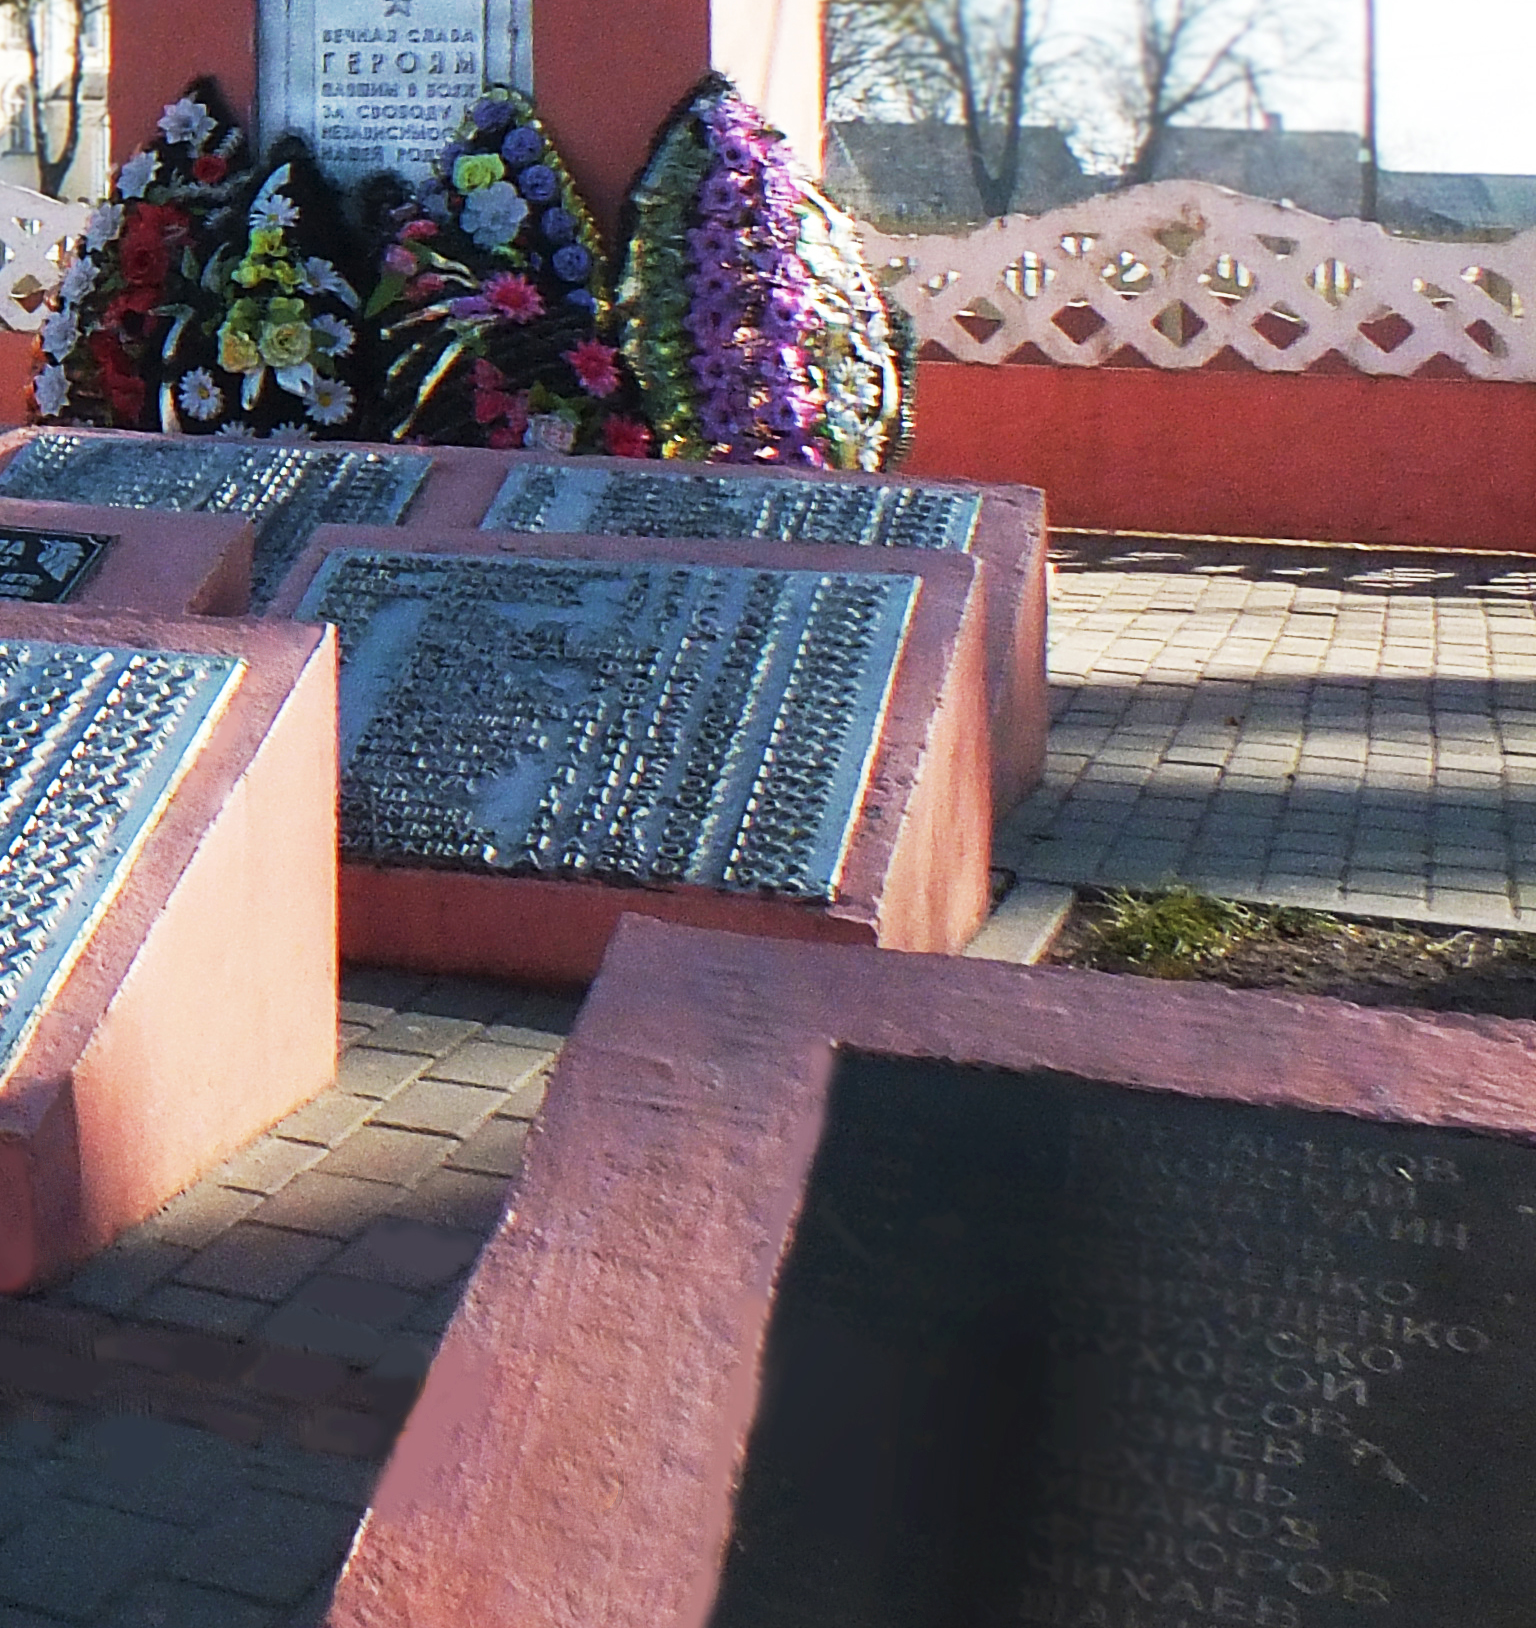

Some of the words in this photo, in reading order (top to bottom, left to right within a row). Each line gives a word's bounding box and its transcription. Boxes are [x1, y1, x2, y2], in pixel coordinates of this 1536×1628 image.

[321, 28, 398, 44] ВЕЧНАЯ
[406, 27, 475, 44] СЛАВА
[322, 50, 476, 76] ГЕРОЯМ
[407, 82, 418, 98] В
[426, 82, 477, 98] БОЯХ
[322, 104, 345, 120] ЗА
[356, 104, 452, 121] СВОБОДУ
[321, 124, 460, 142] НЕЗАВИСИМОС
[396, 146, 440, 162] РОД
[1030, 1511, 1391, 1607] ФЕДОРОВ
